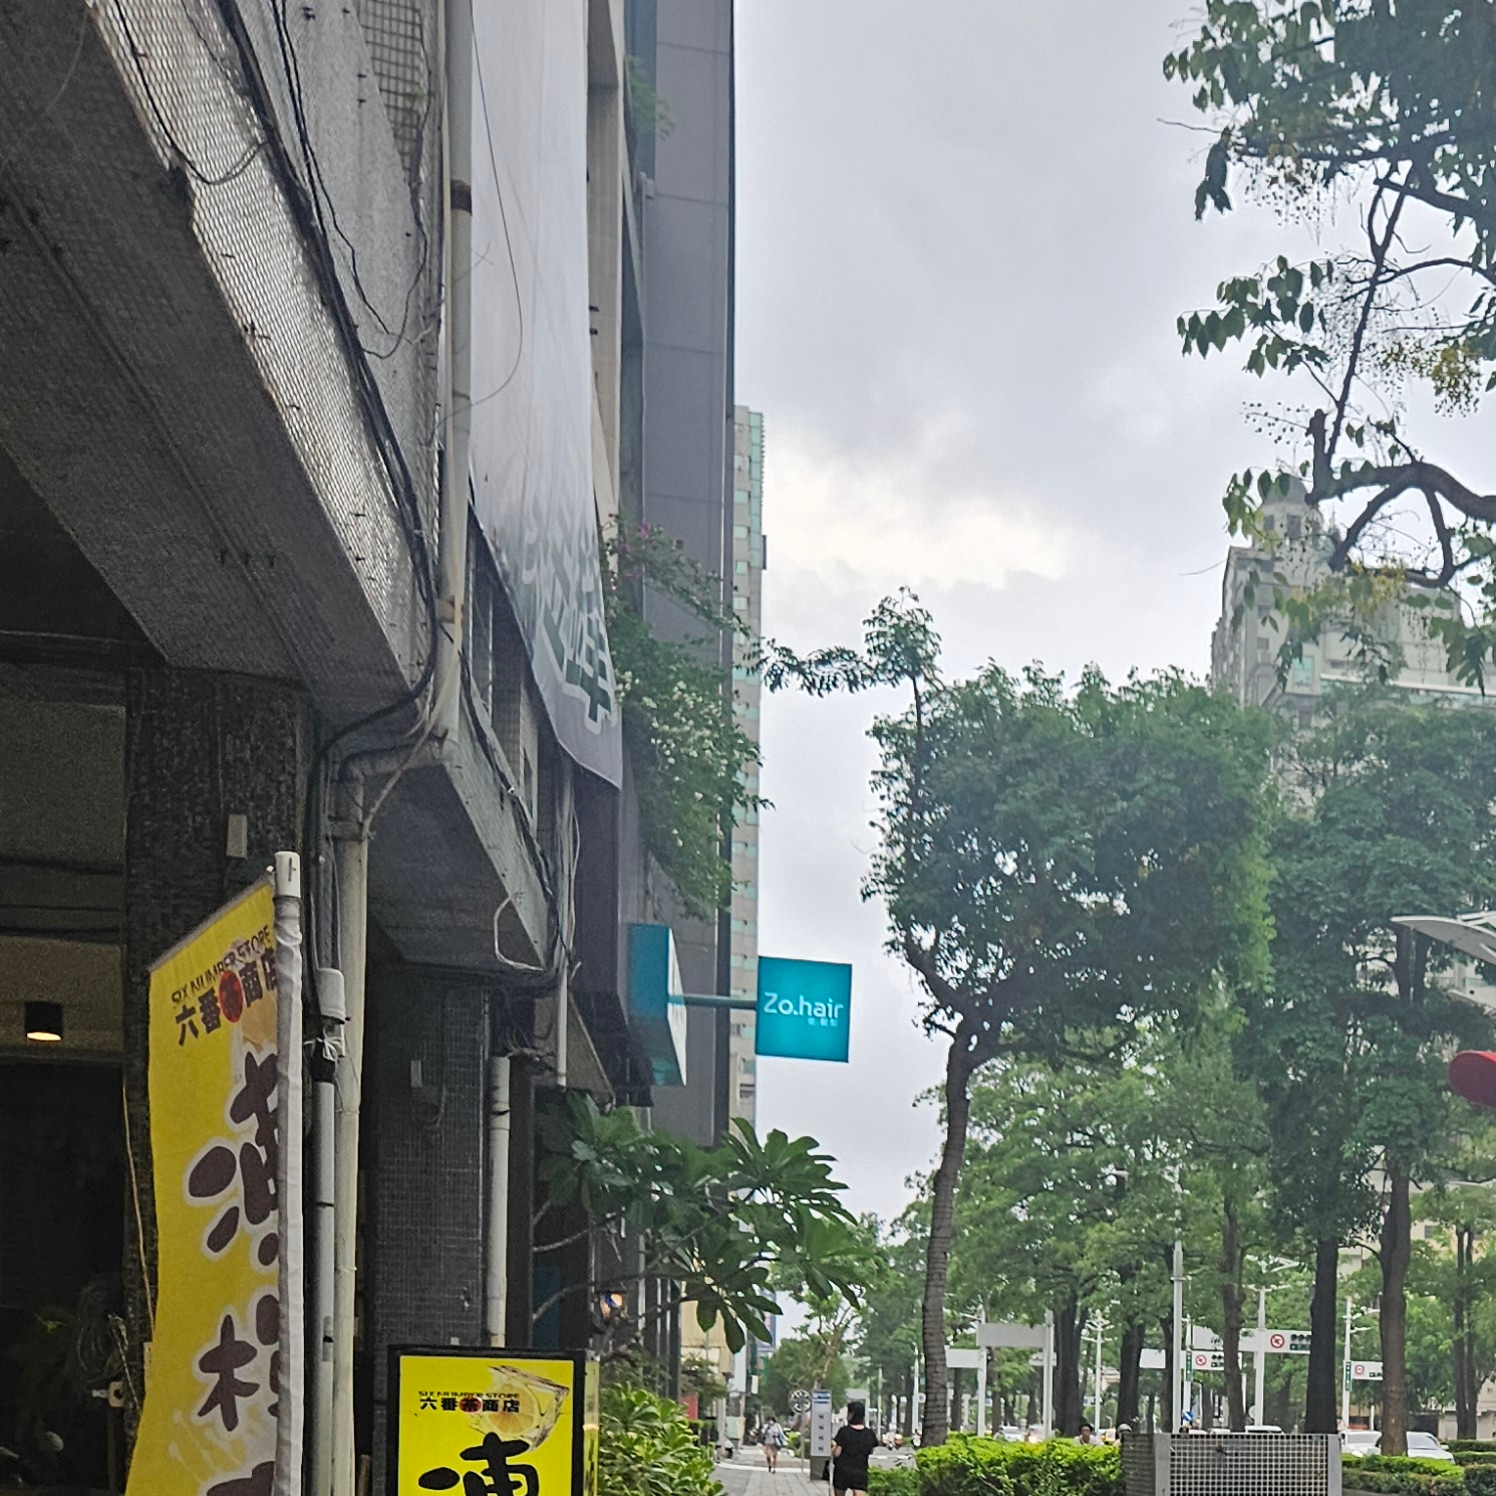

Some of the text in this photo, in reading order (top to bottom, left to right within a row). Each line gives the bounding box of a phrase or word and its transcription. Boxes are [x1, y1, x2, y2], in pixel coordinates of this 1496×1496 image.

[763, 991, 844, 1019] Zo.hair
[419, 1397, 521, 1413] 六番茶商店
